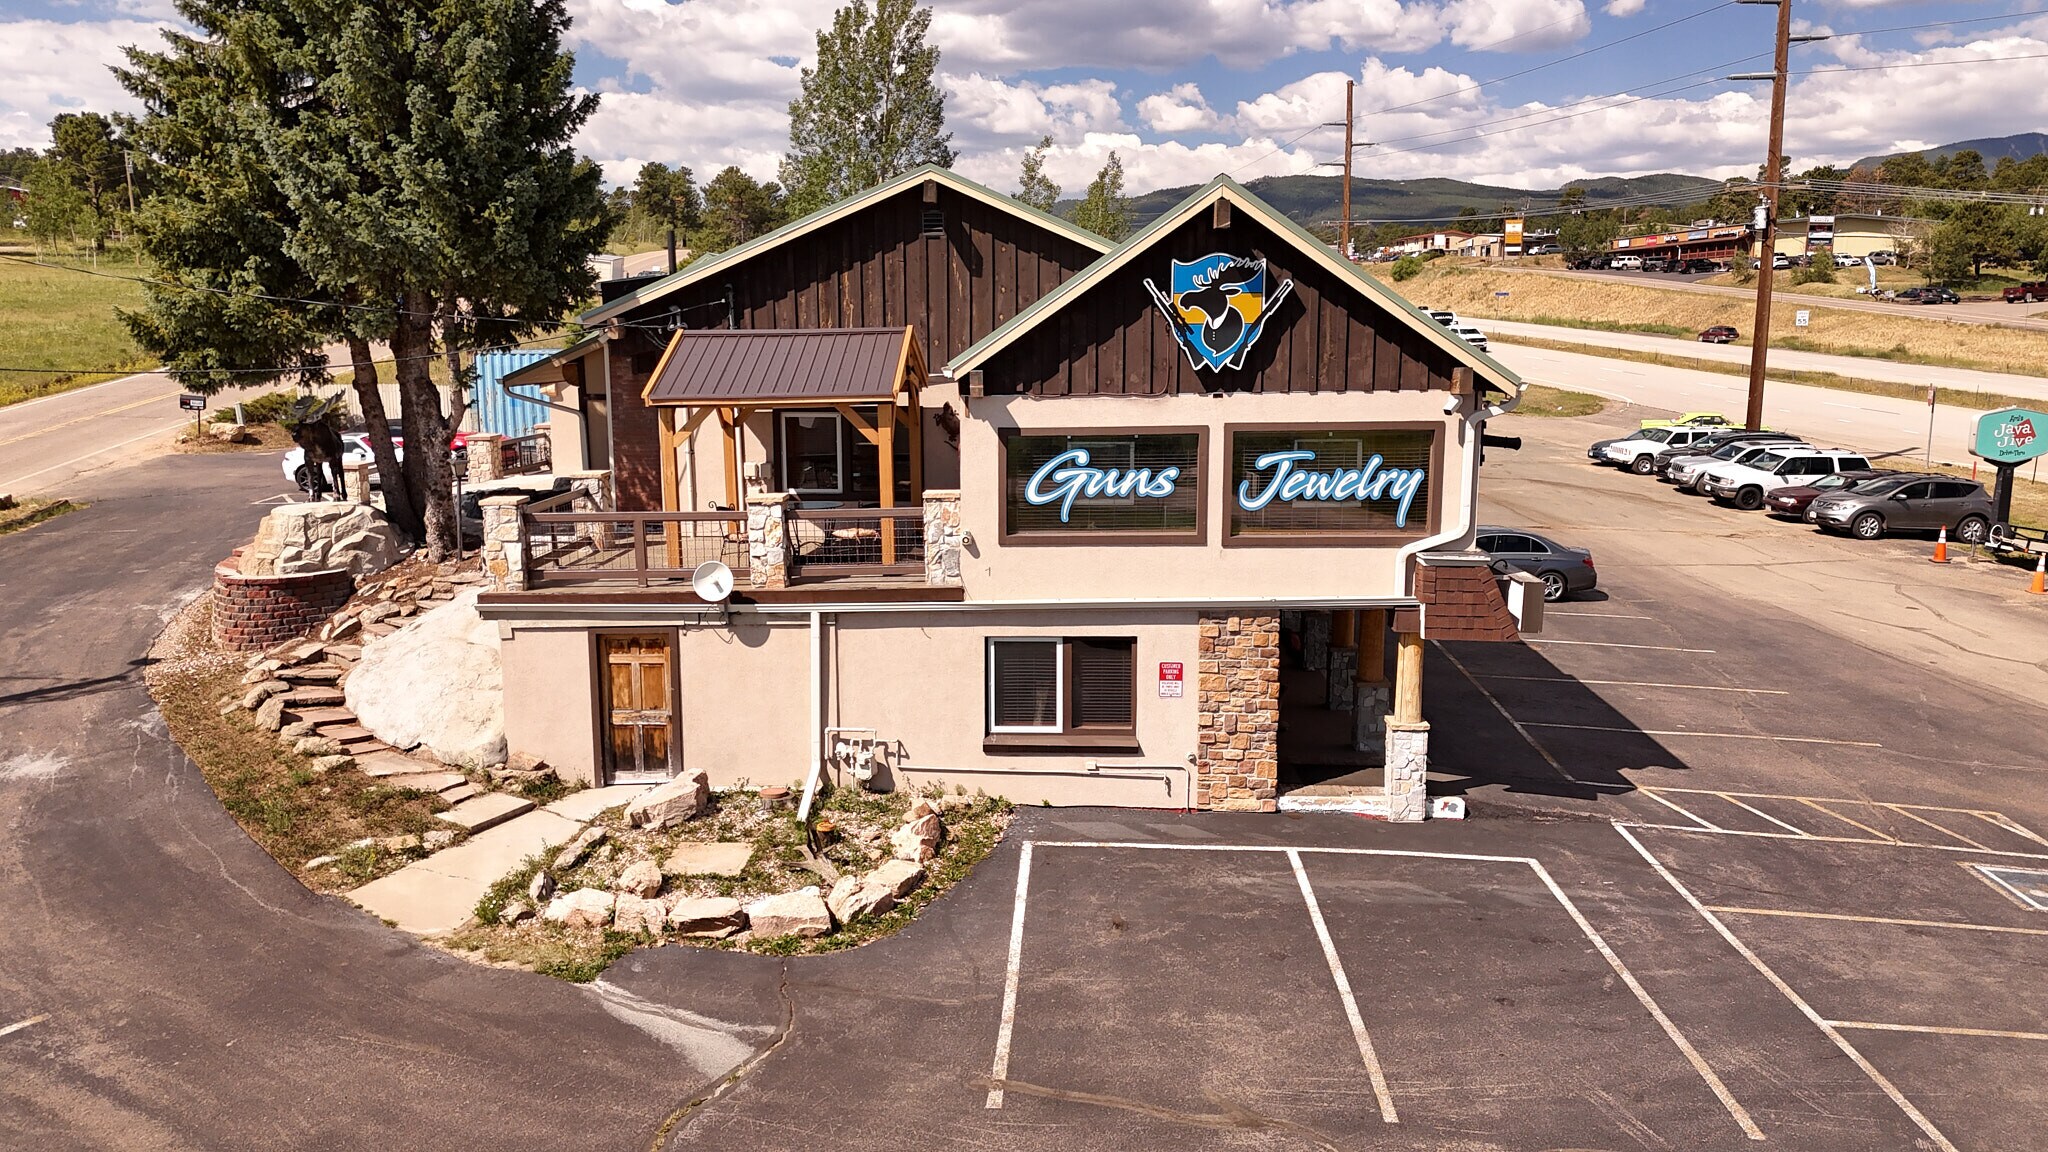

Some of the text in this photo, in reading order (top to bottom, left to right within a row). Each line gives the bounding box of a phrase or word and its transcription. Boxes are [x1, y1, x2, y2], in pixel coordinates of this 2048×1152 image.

[1994, 423, 2032, 438] Java
[1997, 435, 2034, 448] Jive
[1025, 448, 1180, 523] Guns
[1238, 450, 1425, 528] Jewelry
